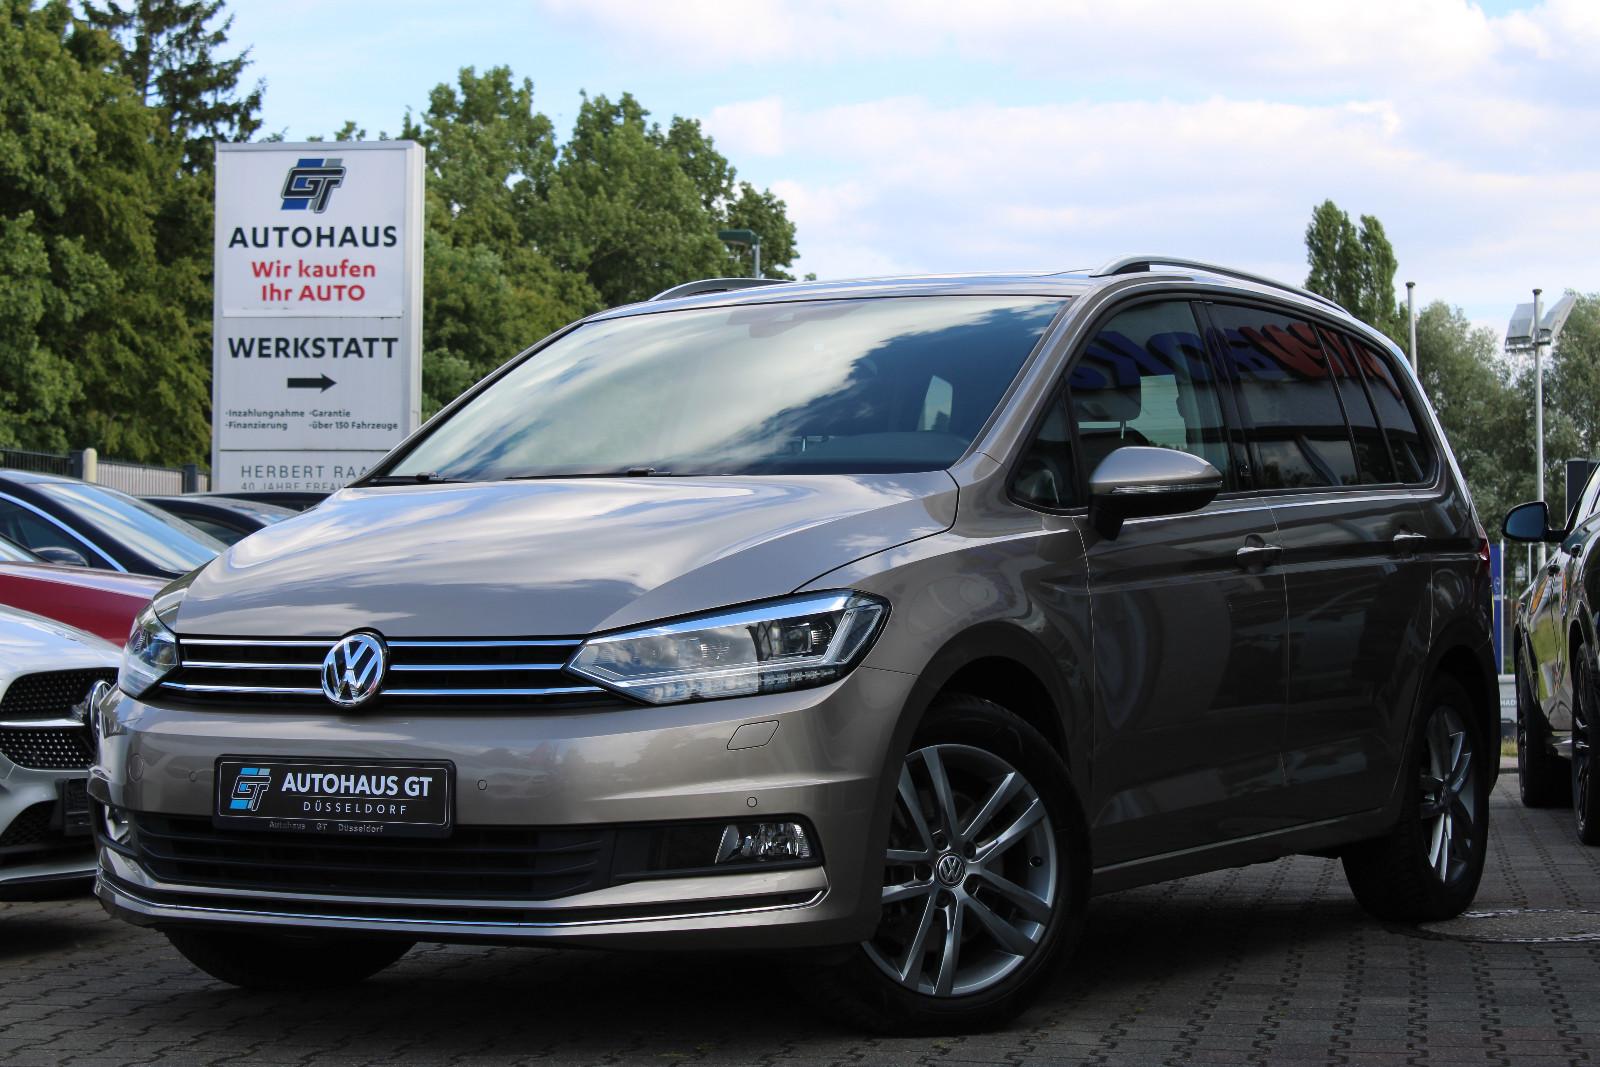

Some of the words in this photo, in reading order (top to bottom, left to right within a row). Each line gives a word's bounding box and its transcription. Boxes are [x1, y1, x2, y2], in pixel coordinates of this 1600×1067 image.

[281, 165, 347, 214] GT
[228, 225, 398, 249] AUTOHAUS
[252, 259, 292, 278] Wir
[298, 258, 376, 278] kaufen
[262, 283, 293, 302] Ihr
[298, 284, 366, 302] AUTO
[228, 336, 399, 359] WERKSTATT
[335, 421, 350, 430] 150
[351, 421, 398, 432] Fahrzeuge
[240, 464, 325, 479] HERBERT
[333, 465, 371, 479] RAA
[281, 772, 399, 796] AUTOHAUS
[404, 776, 433, 797] GT
[302, 799, 408, 815] DÜSSELDORF
[316, 822, 328, 832] GT
[337, 823, 384, 833] Düsseldorf
